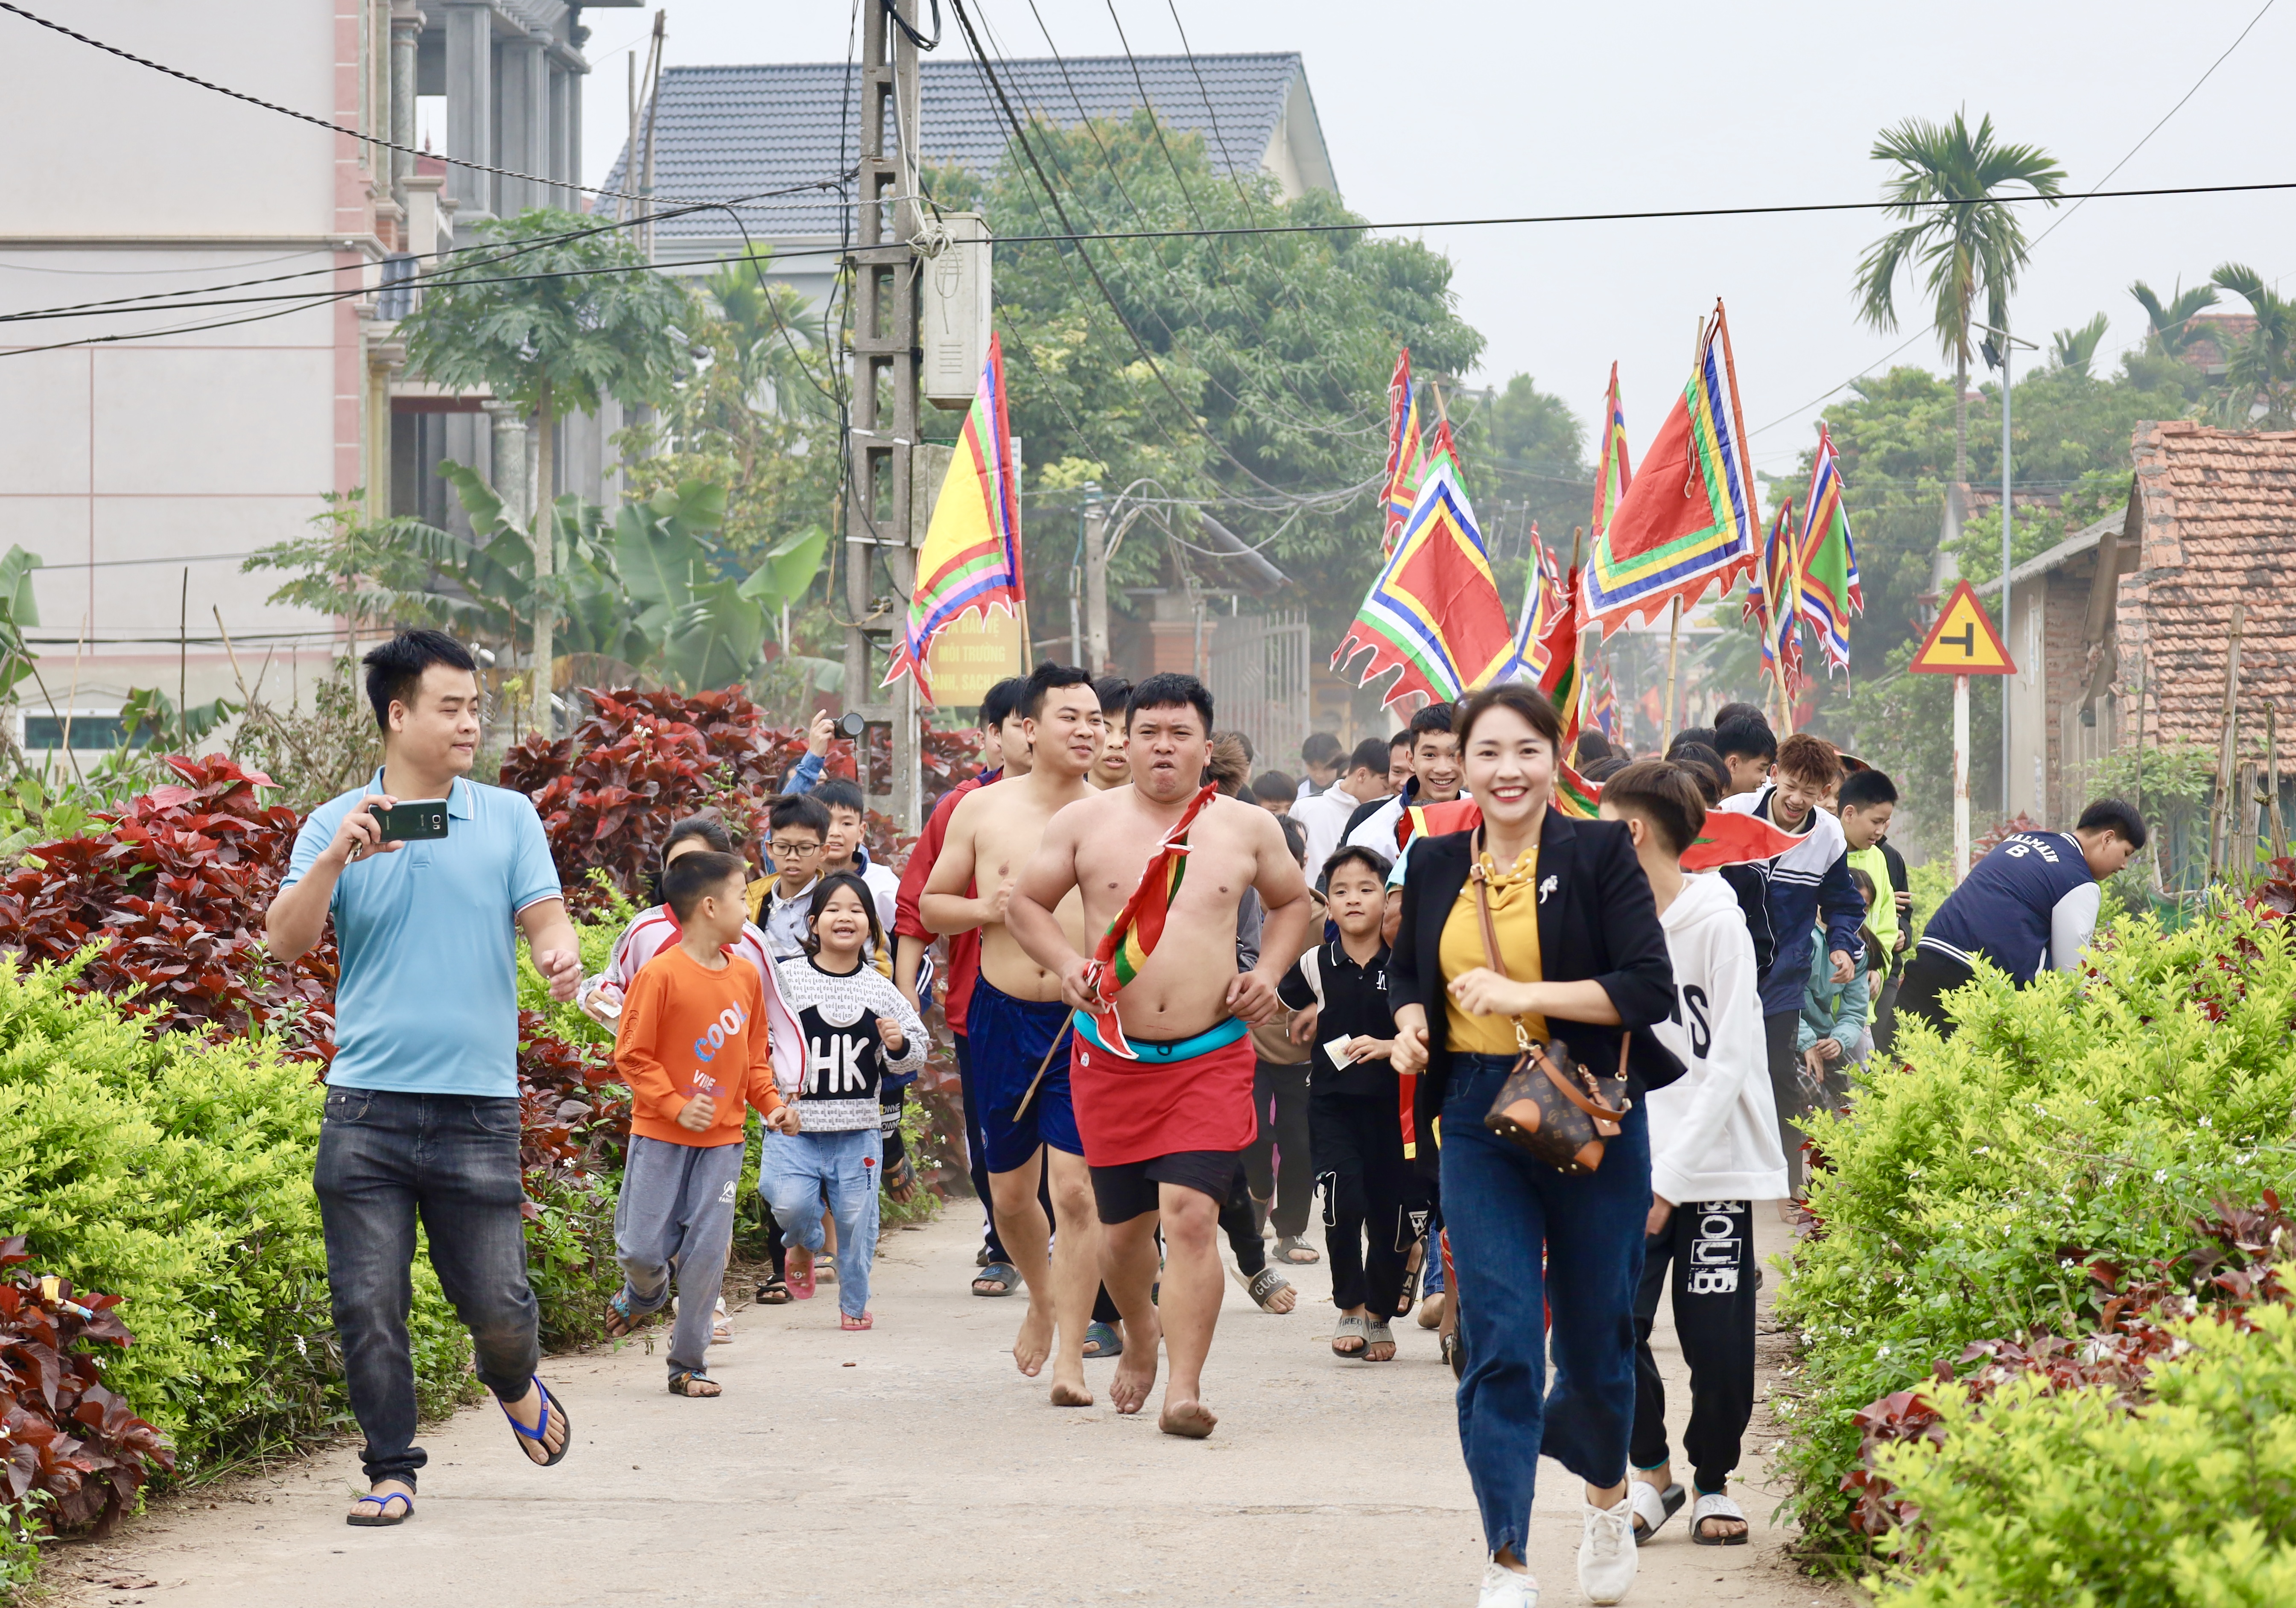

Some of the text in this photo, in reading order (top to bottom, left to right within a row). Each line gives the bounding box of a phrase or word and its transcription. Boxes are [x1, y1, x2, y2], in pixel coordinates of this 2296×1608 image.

[939, 642, 1005, 662] MÔI TRƯỜNG
[2003, 834, 2059, 862] BALMAIN
[2005, 844, 2030, 858] B
[695, 1000, 748, 1062] COOL
[810, 1034, 869, 1094] HK
[693, 1069, 716, 1091] VIBE
